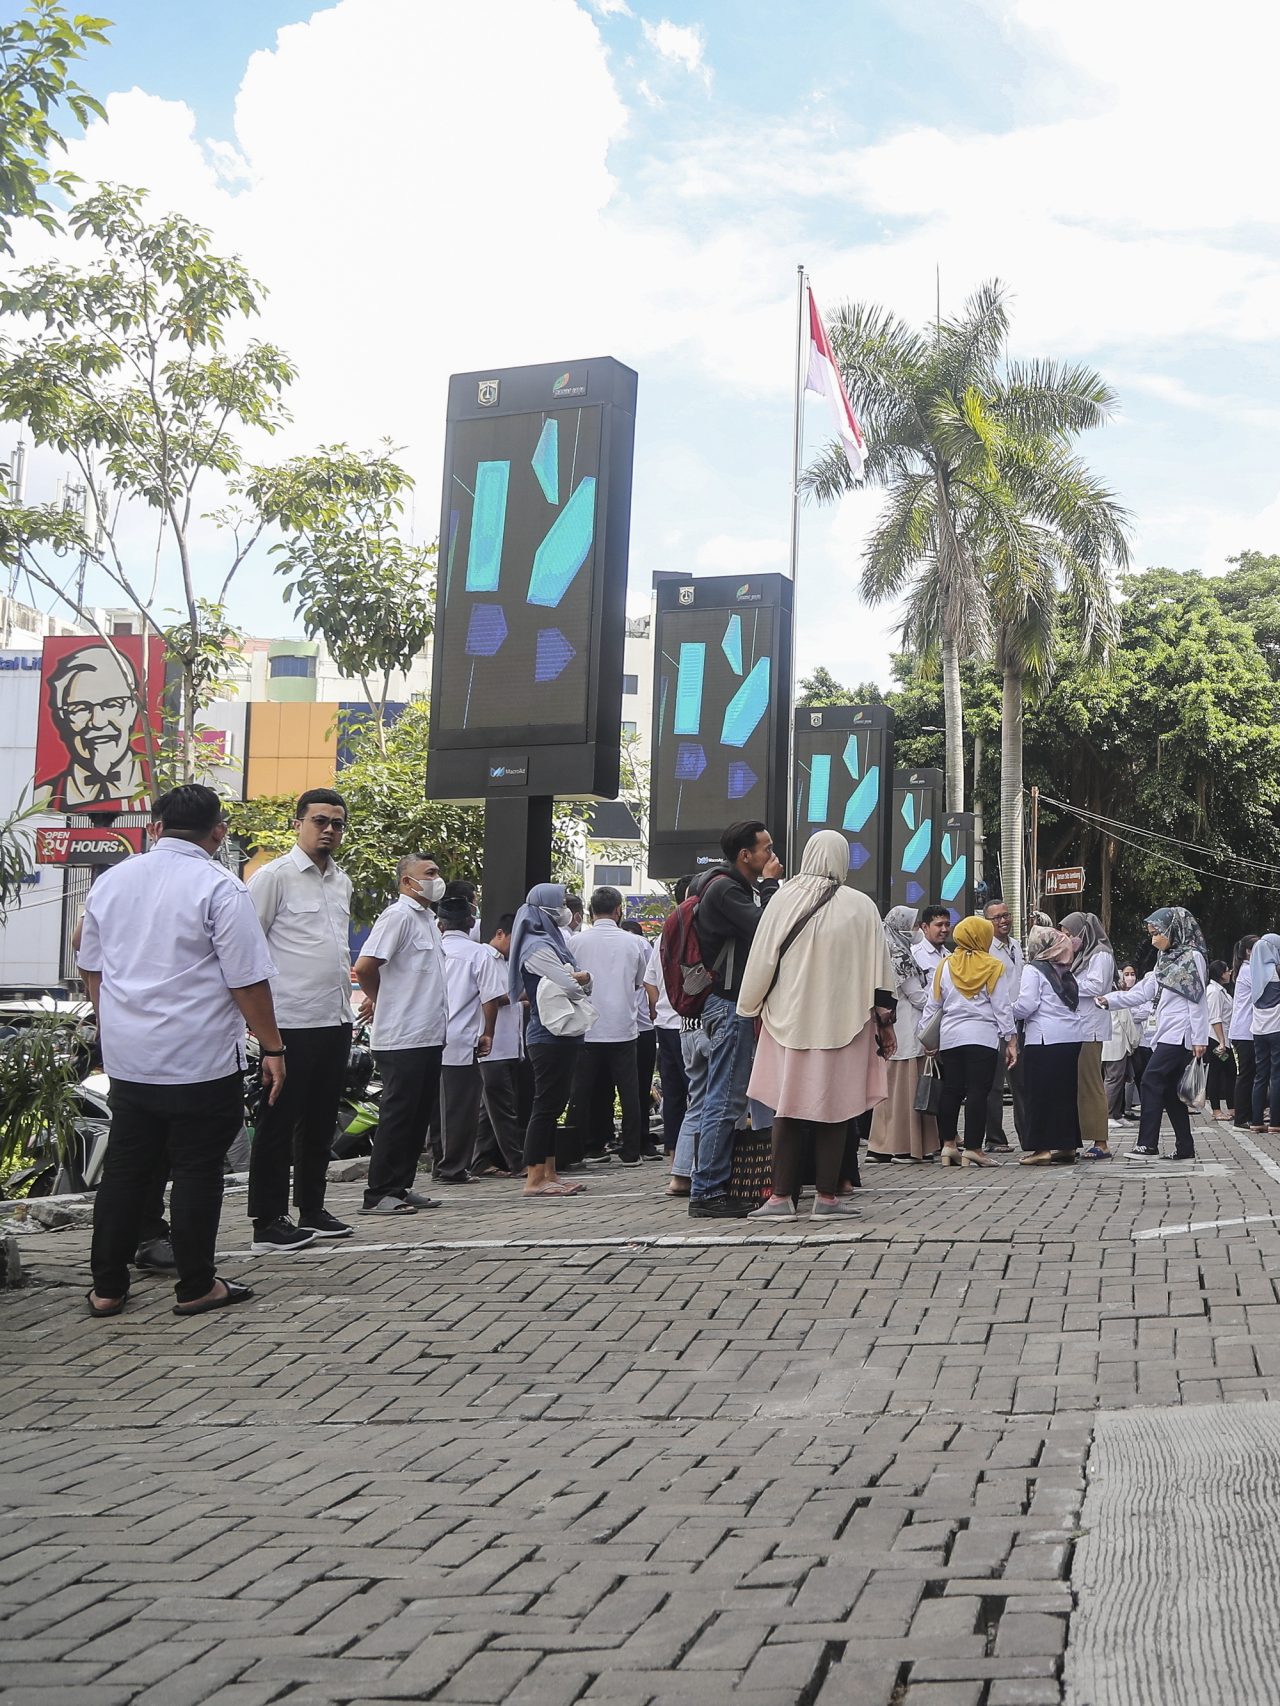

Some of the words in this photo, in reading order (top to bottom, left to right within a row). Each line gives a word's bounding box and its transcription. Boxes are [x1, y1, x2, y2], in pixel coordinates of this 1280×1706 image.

[45, 831, 70, 839] OPEN
[42, 839, 68, 855] 24
[70, 841, 119, 853] HOURS
